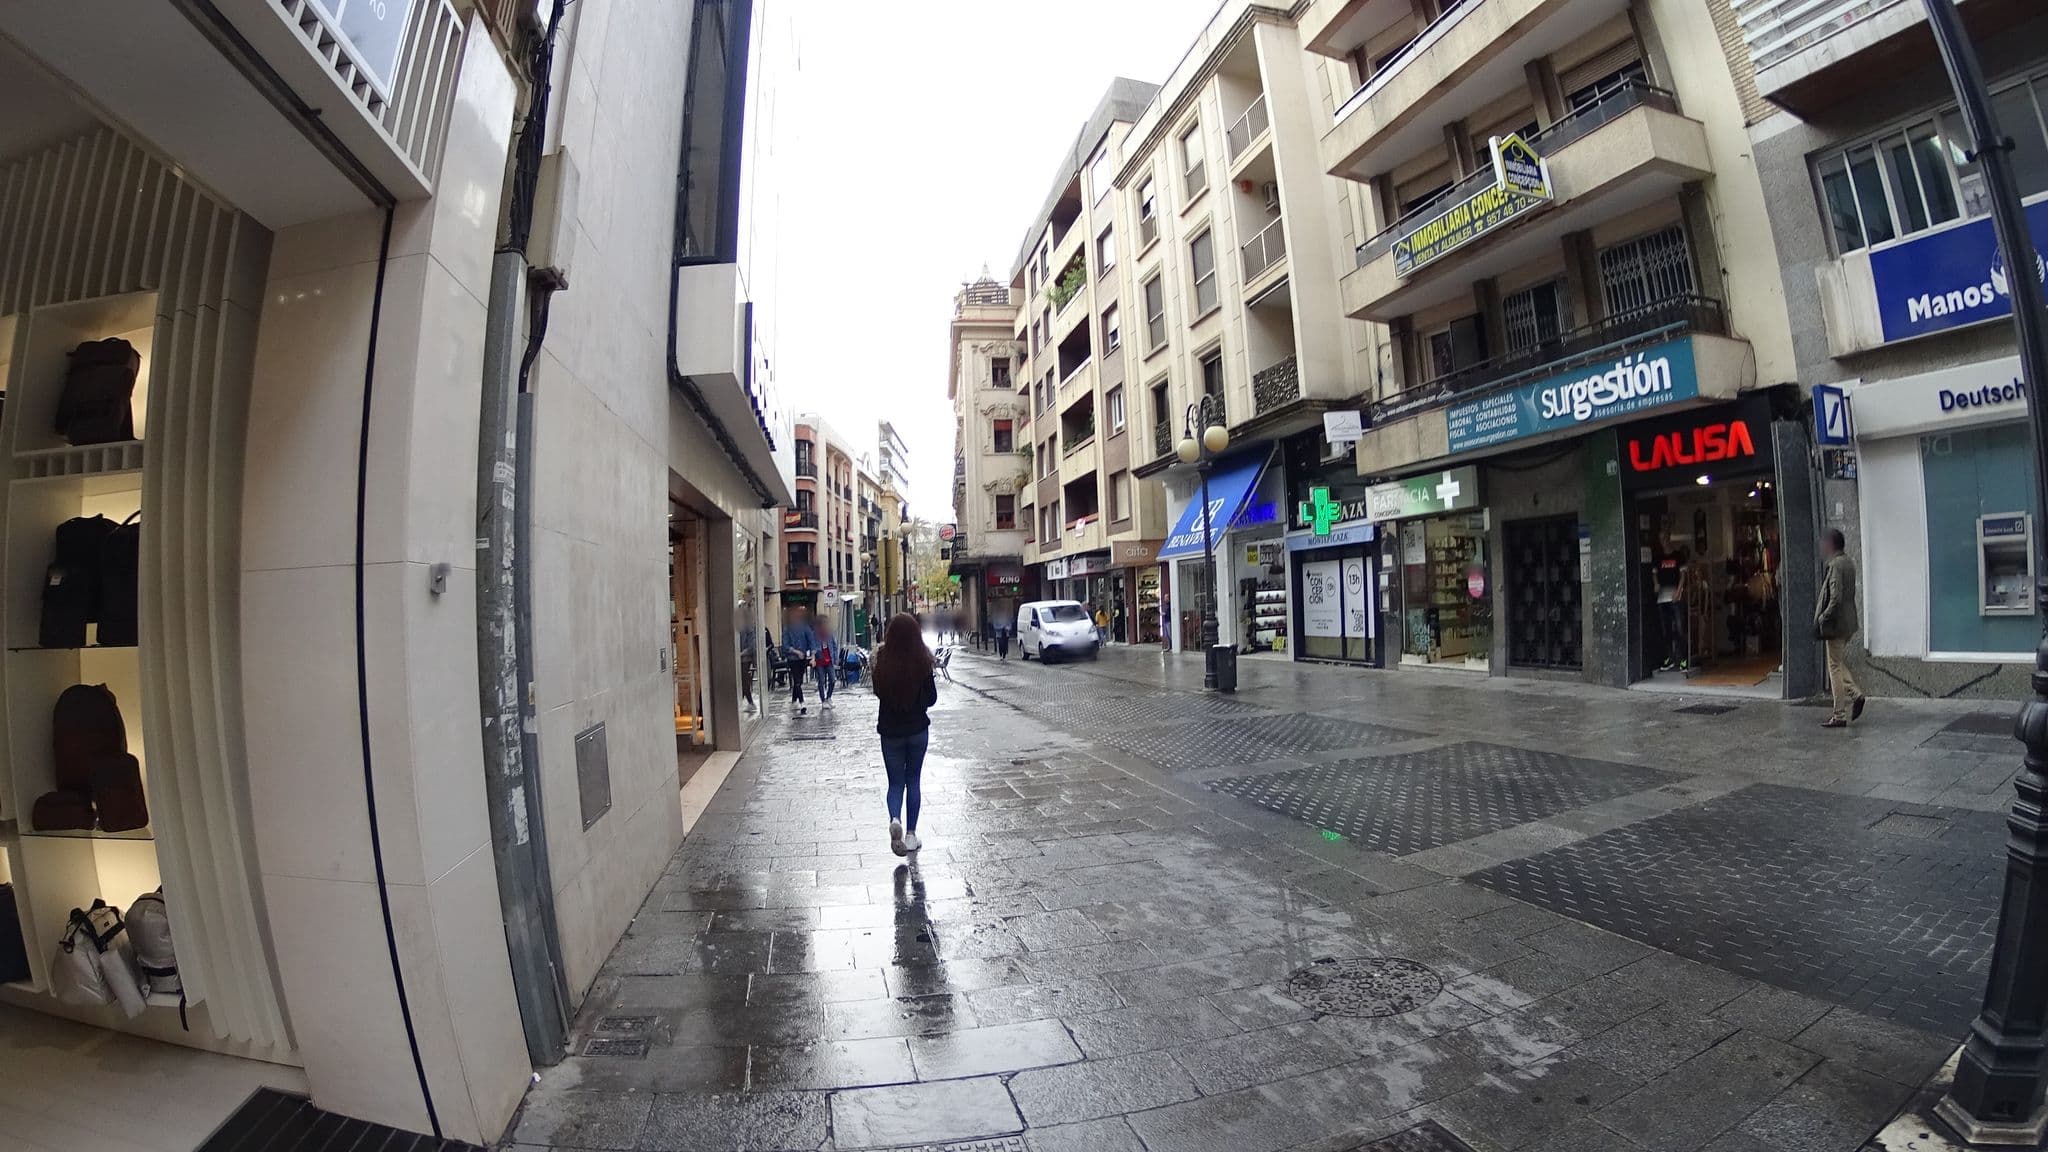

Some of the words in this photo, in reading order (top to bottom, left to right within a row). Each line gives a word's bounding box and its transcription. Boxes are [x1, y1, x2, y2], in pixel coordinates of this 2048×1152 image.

[1411, 208, 1471, 253] INMOBILIARIA
[1414, 248, 1434, 265] VENTA
[1434, 242, 1440, 254] Y
[1441, 226, 1472, 251] ALQUILER
[1514, 196, 1526, 211] 70
[1907, 282, 1995, 323] Manos
[1541, 352, 1672, 421] surgestión
[1627, 400, 1635, 410] de
[1638, 392, 1673, 408] empresas
[1449, 415, 1473, 430] LABORAL
[1476, 403, 1517, 421] CONTABILIDAD
[1450, 402, 1479, 419] IMPUESTOS
[1482, 392, 1514, 409] ESPECIALES
[1449, 427, 1466, 440] FISCAL
[1476, 413, 1518, 433] ASOCIACIONES
[1629, 420, 1755, 471] LALISA
[1349, 574, 1360, 585] 13h
